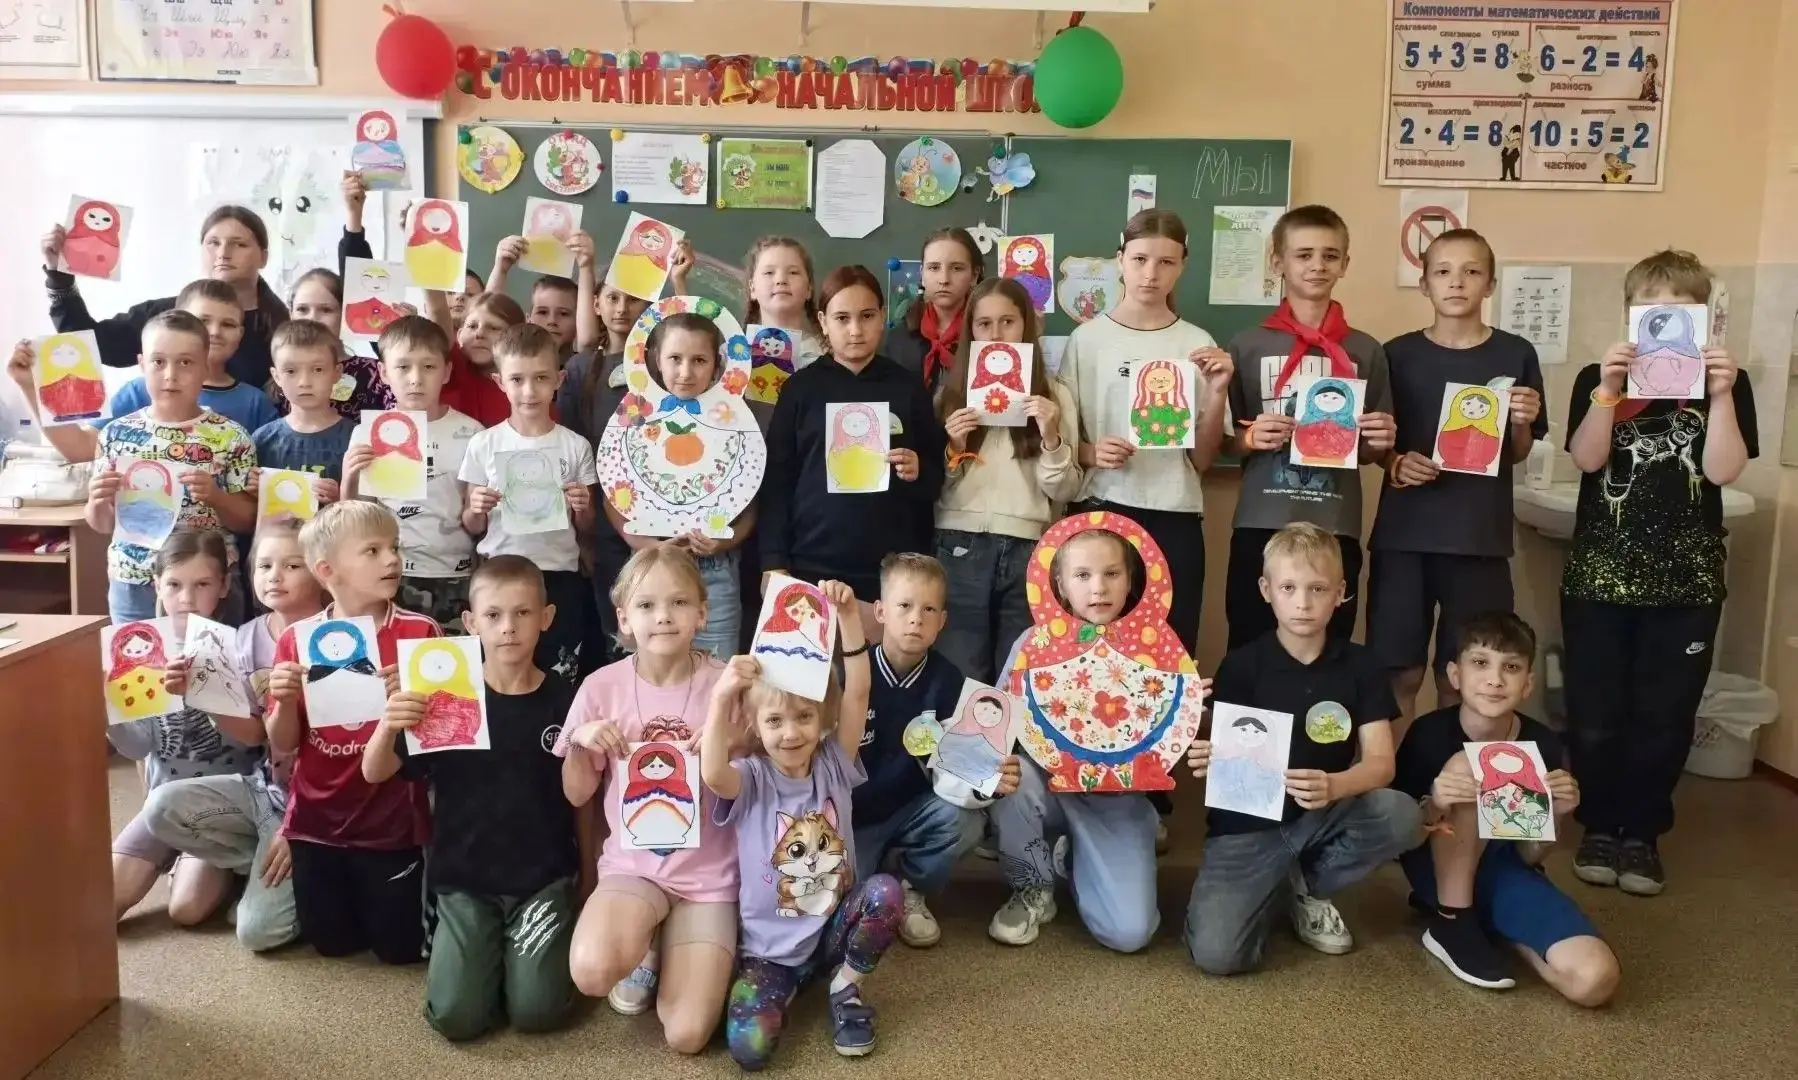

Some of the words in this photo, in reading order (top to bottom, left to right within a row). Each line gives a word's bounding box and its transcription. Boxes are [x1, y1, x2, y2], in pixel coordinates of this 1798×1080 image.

[1403, 2, 1484, 17] Компоненты
[1488, 7, 1596, 20] математических
[1599, 6, 1660, 22] действий
[1492, 30, 1520, 38] сумма
[1405, 41, 1420, 68] 5
[1428, 44, 1442, 65] +
[1450, 41, 1465, 68] 3
[1473, 48, 1486, 63] =
[1495, 42, 1509, 69] 8
[1540, 44, 1555, 71] 6
[1581, 45, 1597, 72] 2
[1606, 52, 1619, 67] =
[1627, 46, 1645, 72] 4
[501, 63, 711, 106] ОКОНЧАНИЕМ
[776, 70, 957, 112] НАЧАЛЬНОЙ
[965, 71, 1042, 113] ШКО
[1416, 80, 1452, 91] сумма
[1550, 82, 1593, 92] разность
[1400, 118, 1415, 145] 2
[1438, 119, 1455, 146] 4
[1463, 125, 1480, 141] =
[1488, 120, 1503, 147] 8
[1530, 119, 1561, 147] 10
[1587, 121, 1604, 148] 5
[1610, 127, 1625, 142] =
[1632, 122, 1650, 149] 2
[1394, 158, 1466, 168] произведение
[1544, 161, 1588, 170] частное
[400, 506, 422, 514] NIKE
[405, 559, 416, 571] it
